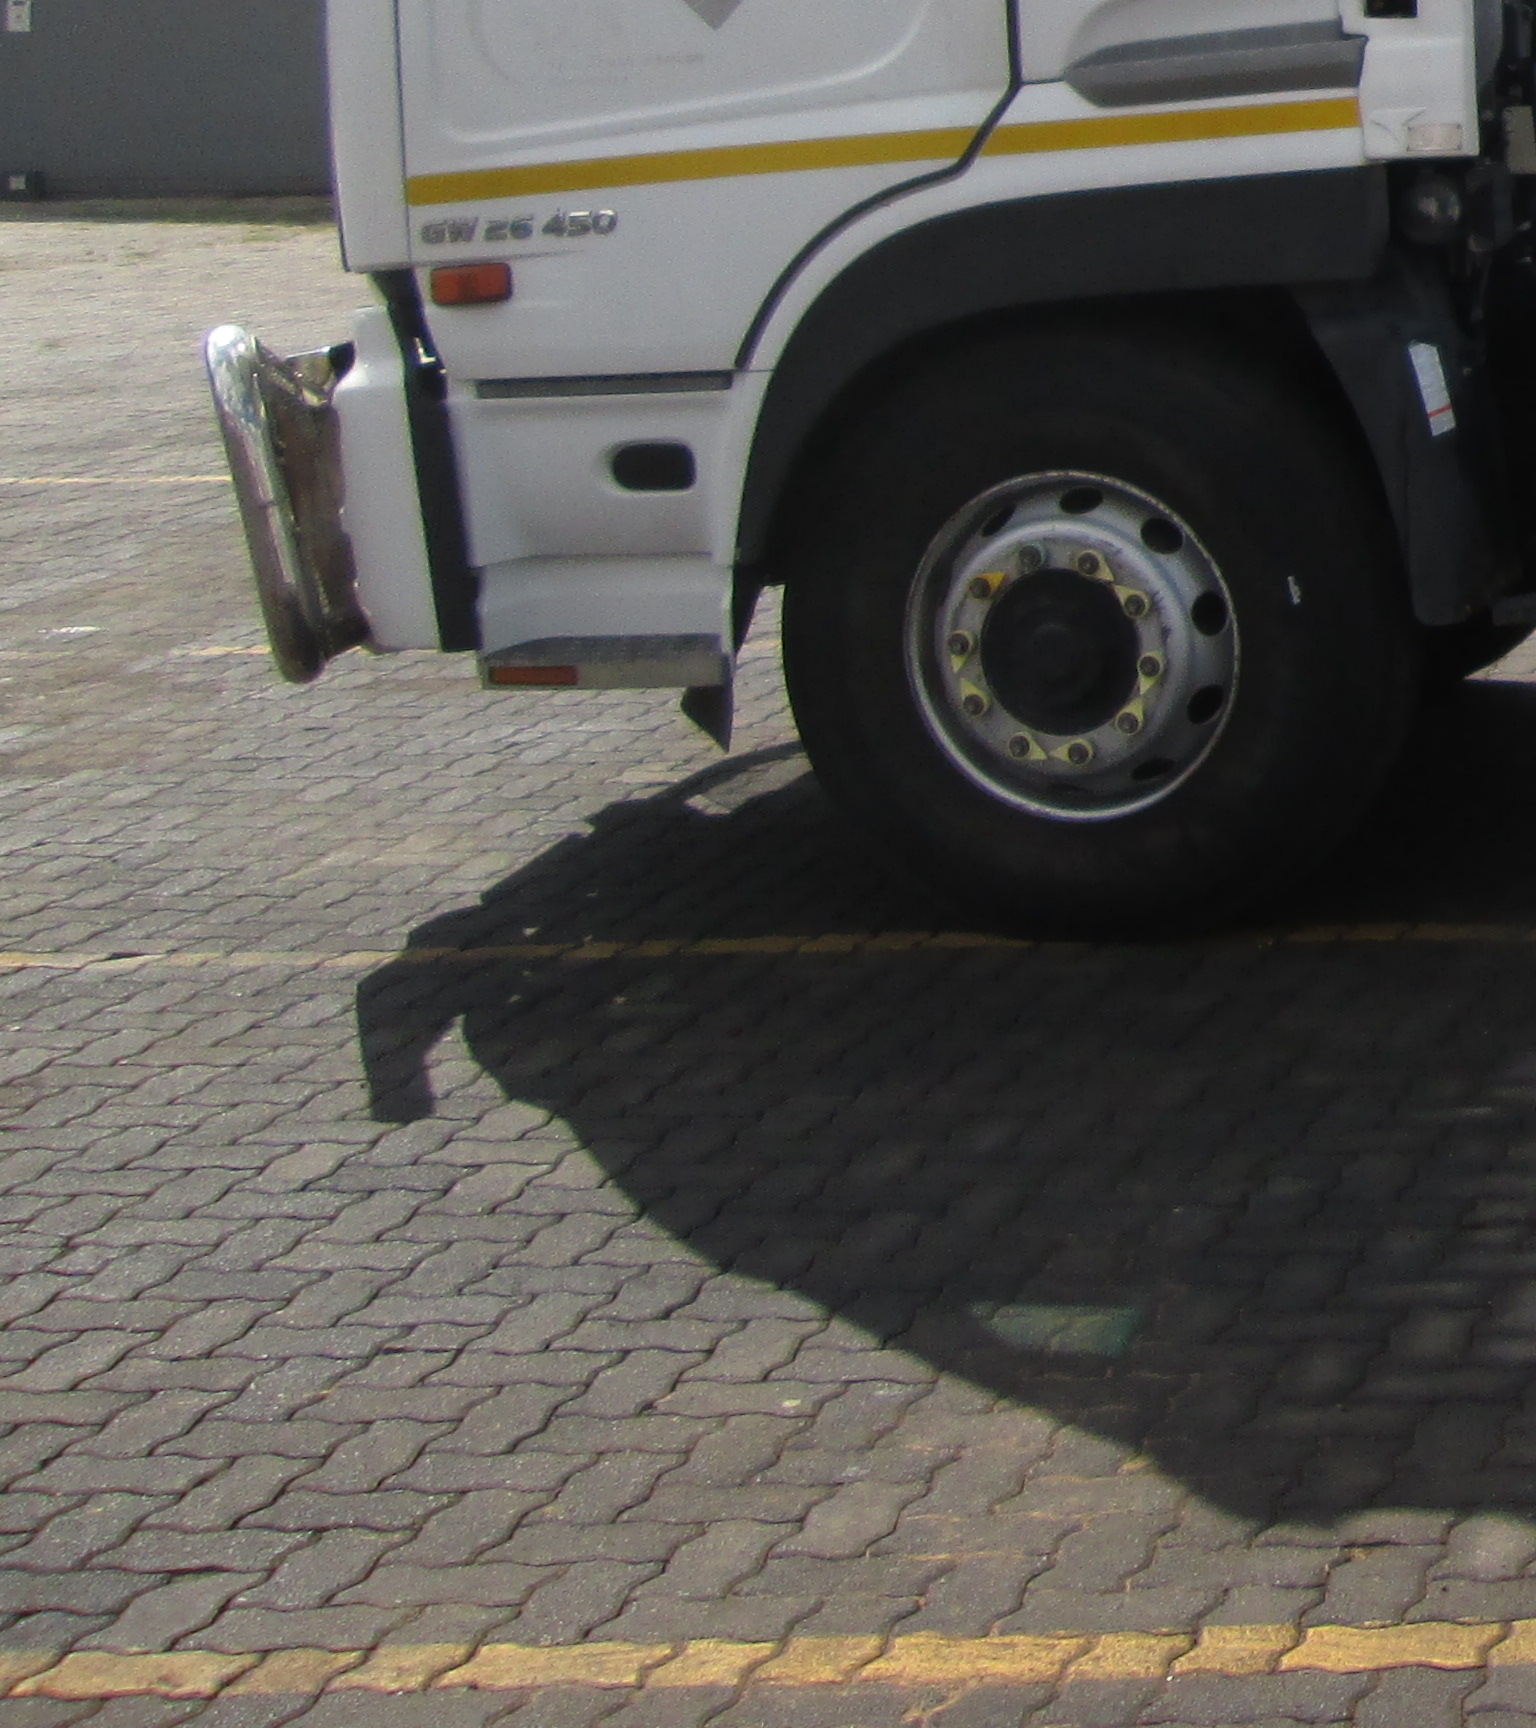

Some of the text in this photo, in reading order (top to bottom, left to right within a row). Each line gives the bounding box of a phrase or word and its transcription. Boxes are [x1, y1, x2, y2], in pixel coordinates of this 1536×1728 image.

[421, 208, 619, 244] GW 26 450
